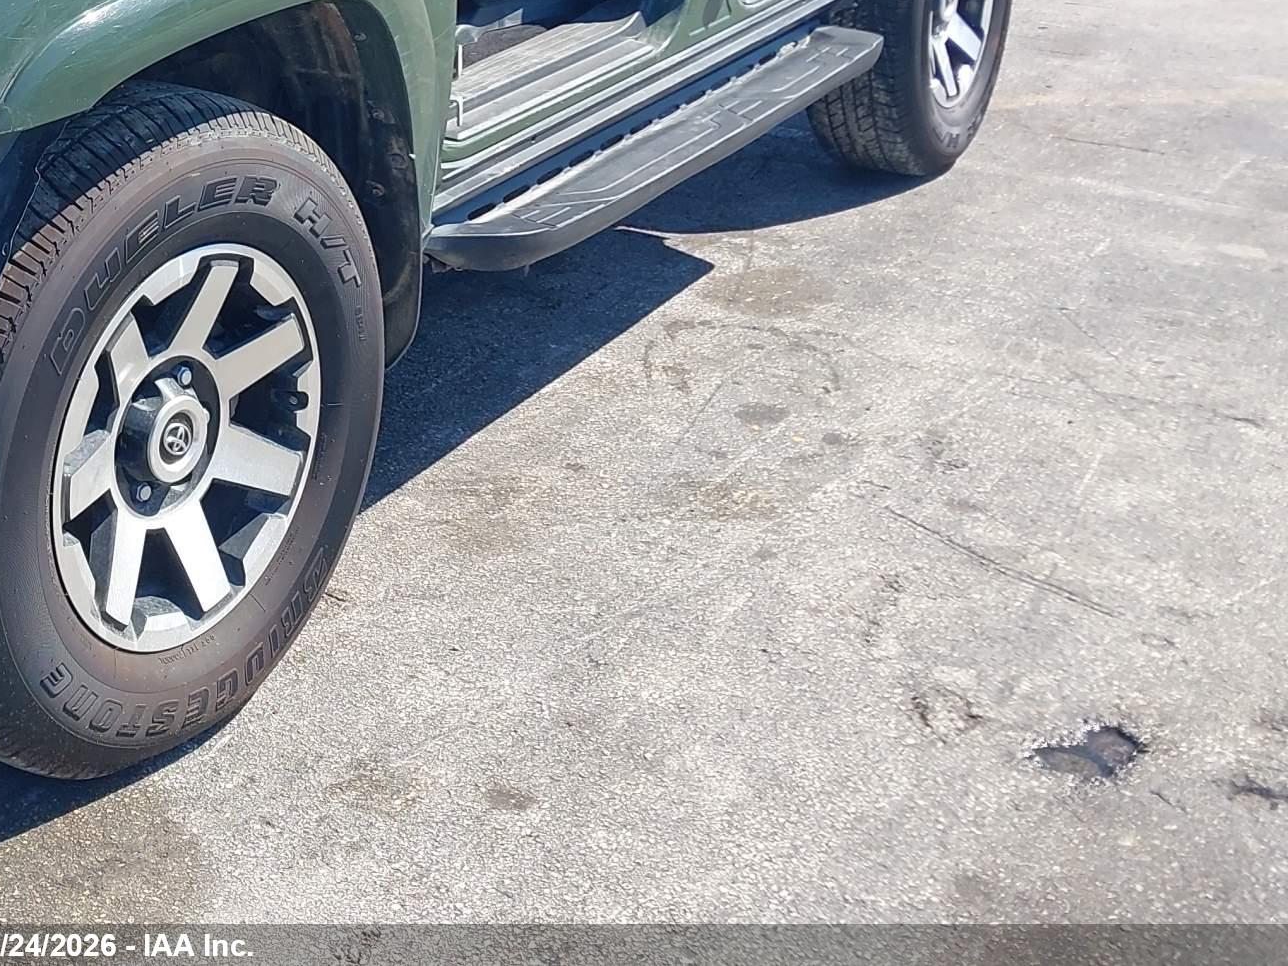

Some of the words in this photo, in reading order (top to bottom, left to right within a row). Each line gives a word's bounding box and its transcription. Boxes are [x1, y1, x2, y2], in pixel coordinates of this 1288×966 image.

[49, 176, 281, 376] DUELER
[292, 196, 362, 288] H/T
[39, 547, 329, 737] BRIDGESTONE
